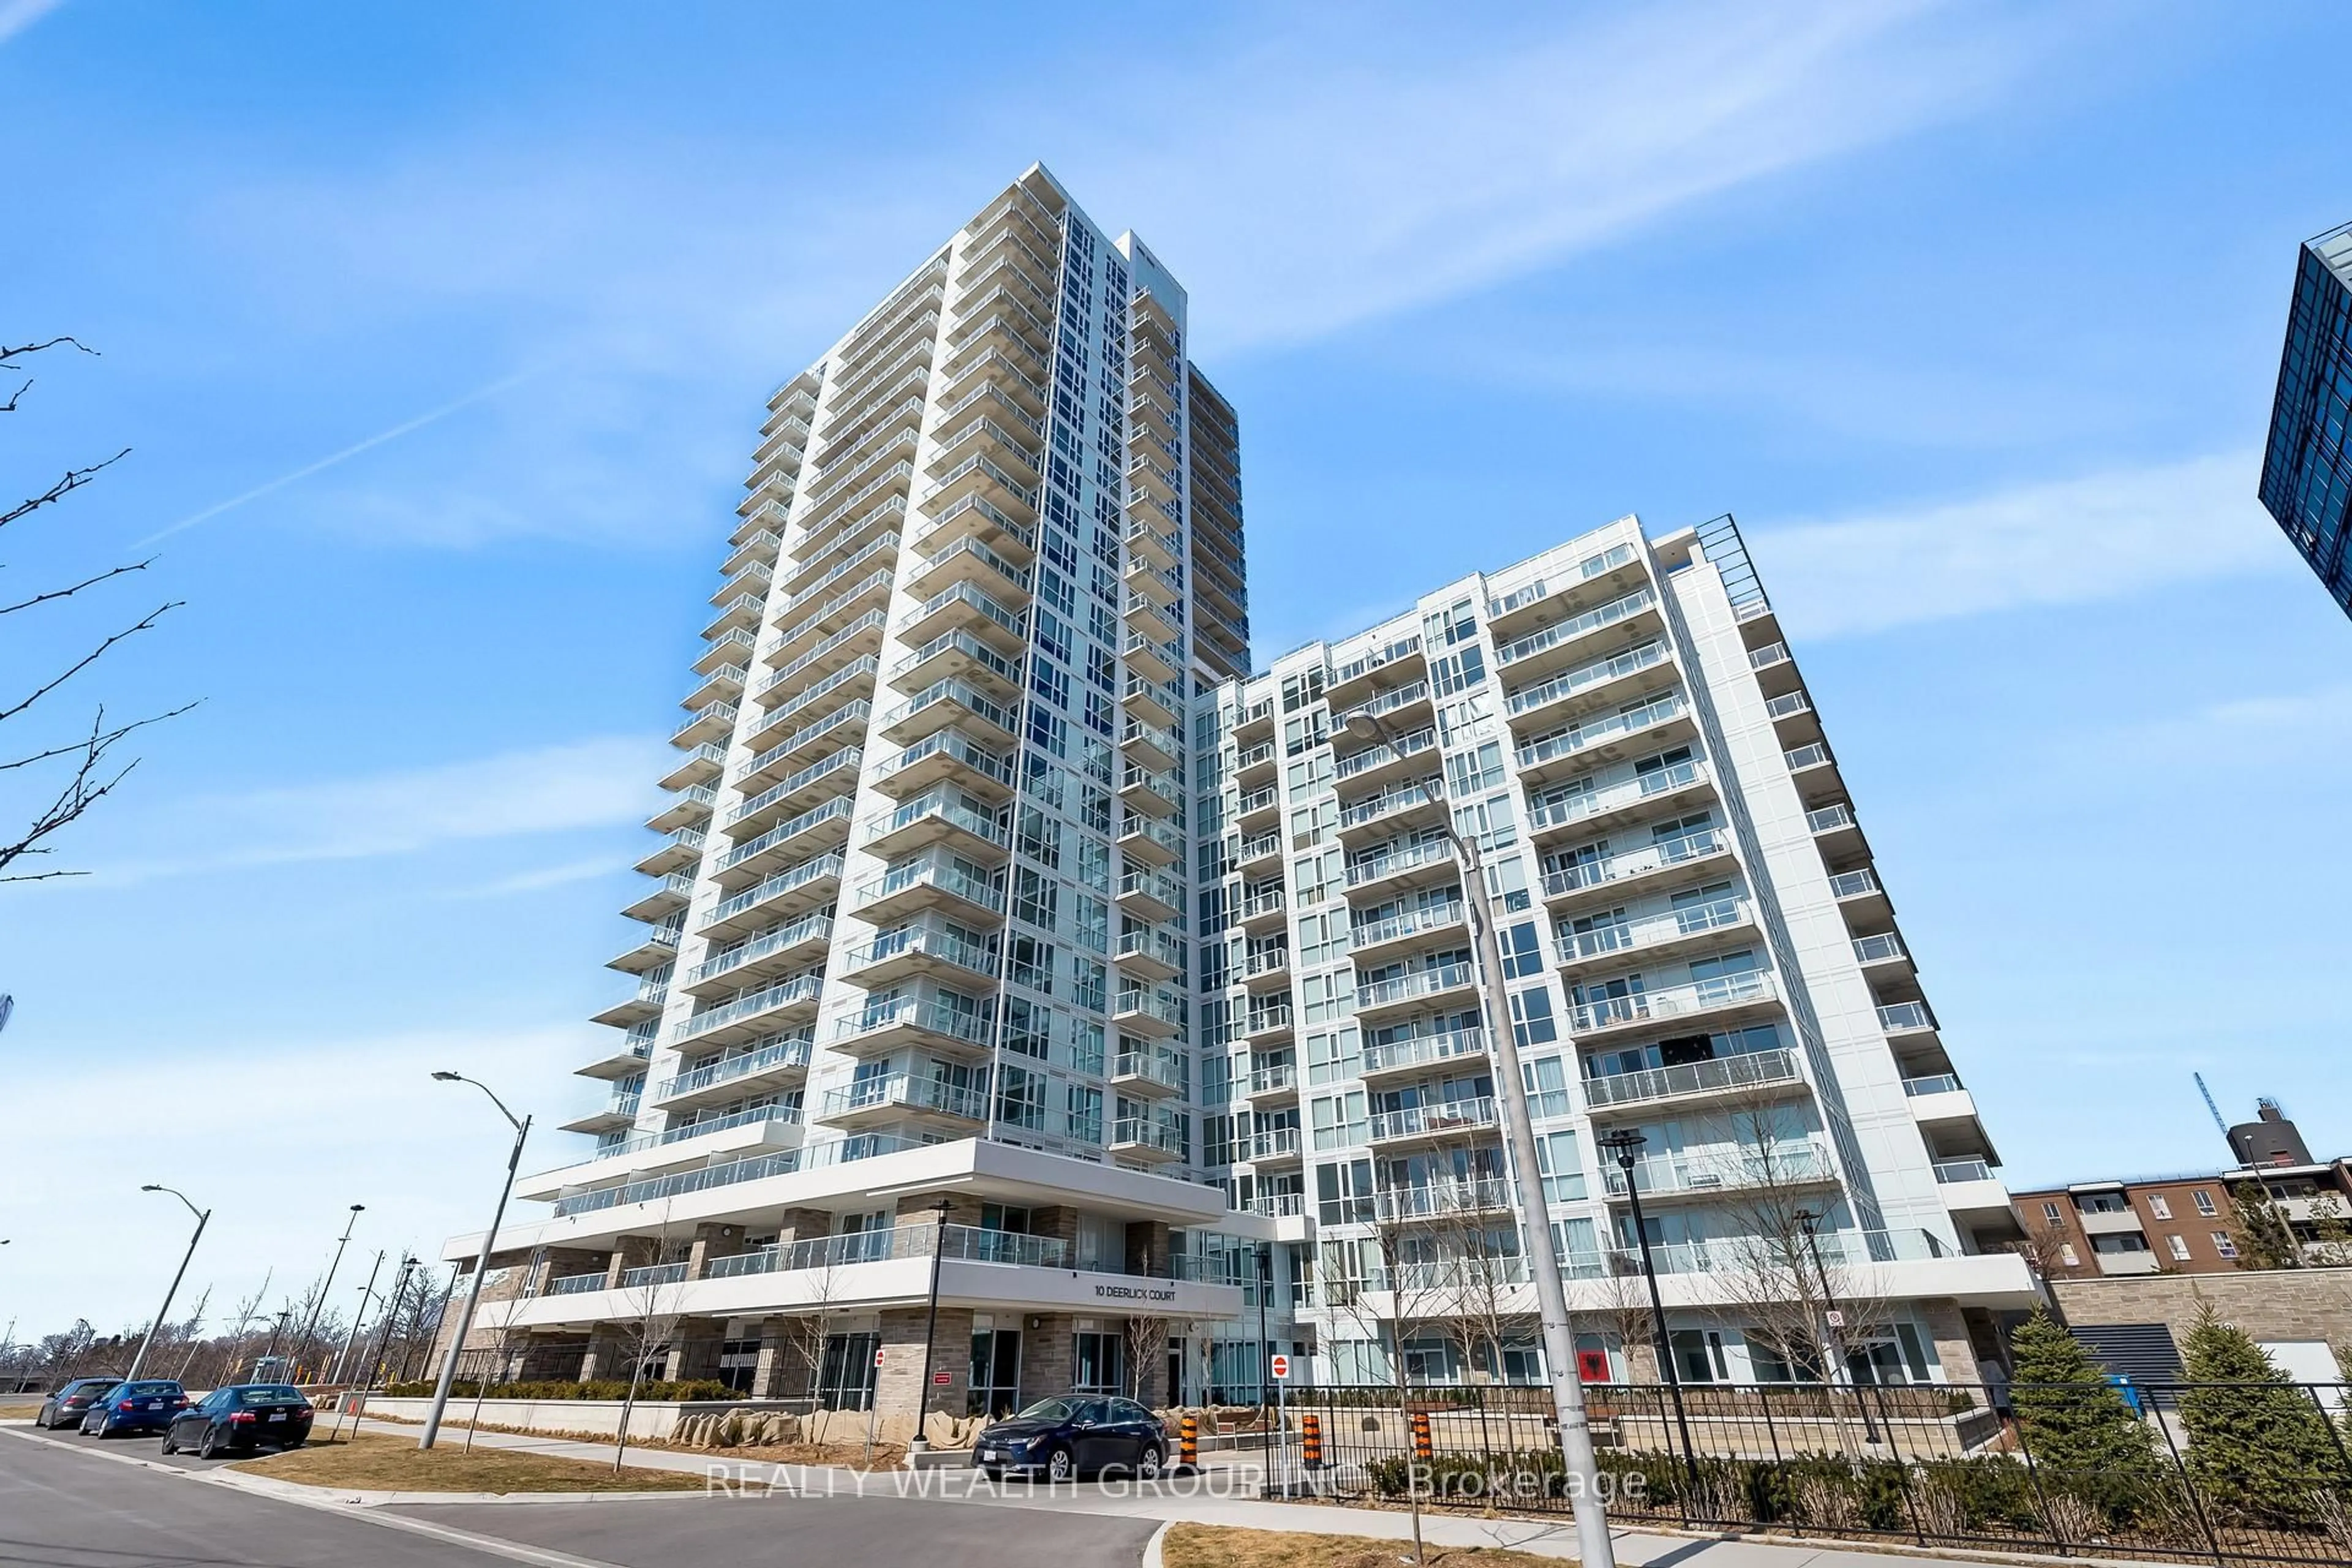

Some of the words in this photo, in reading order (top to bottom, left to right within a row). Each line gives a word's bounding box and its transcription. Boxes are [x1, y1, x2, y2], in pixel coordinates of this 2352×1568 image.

[1095, 1286, 1104, 1297] 10
[1107, 1286, 1147, 1299] DEERLICK
[1149, 1290, 1176, 1301] COURT
